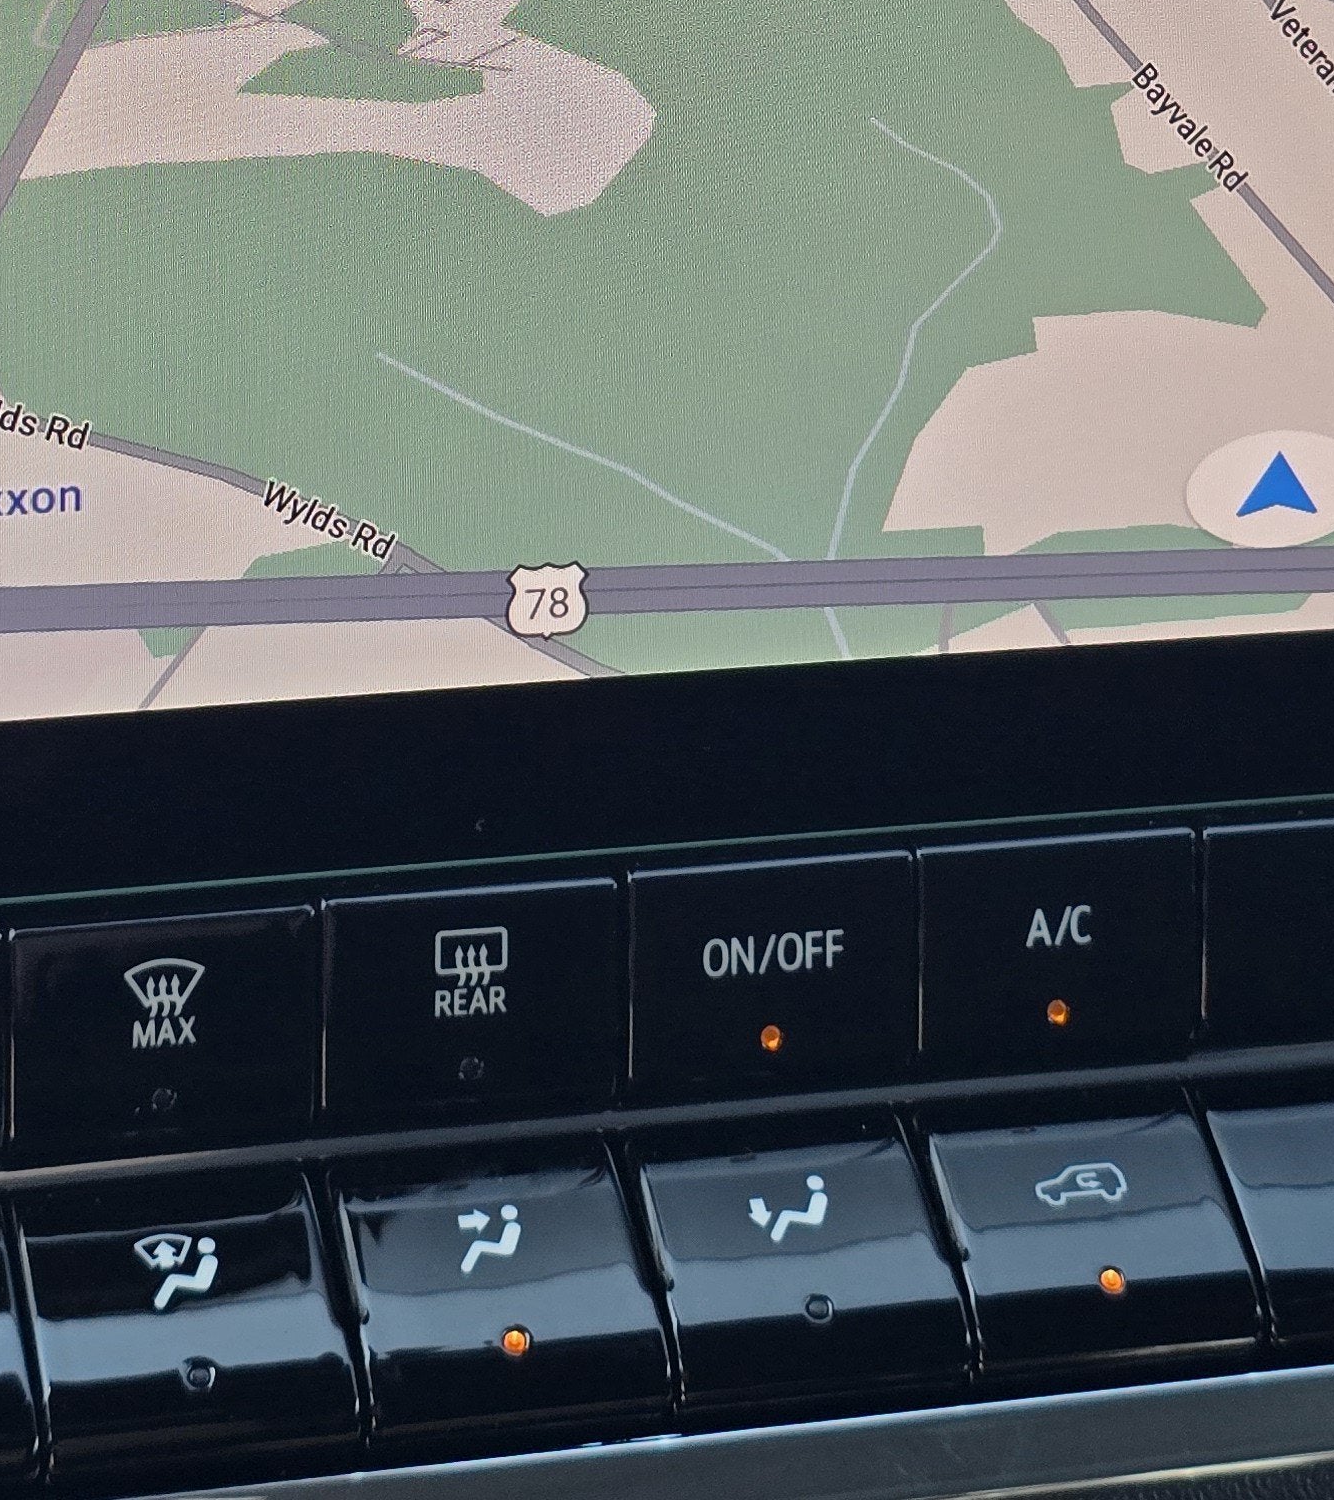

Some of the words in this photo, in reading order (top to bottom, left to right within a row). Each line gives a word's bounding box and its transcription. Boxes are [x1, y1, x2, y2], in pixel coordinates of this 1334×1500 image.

[1132, 63, 1212, 159] Bayvale
[1207, 149, 1249, 193] Rd
[45, 414, 90, 451] Rd
[263, 480, 349, 541] Wylds
[351, 519, 397, 561] Rd
[525, 587, 569, 620] 78
[1025, 905, 1093, 950] A/C
[703, 929, 846, 979] ON/OFF
[434, 985, 508, 1018] REAR
[132, 1015, 197, 1049] MAX
